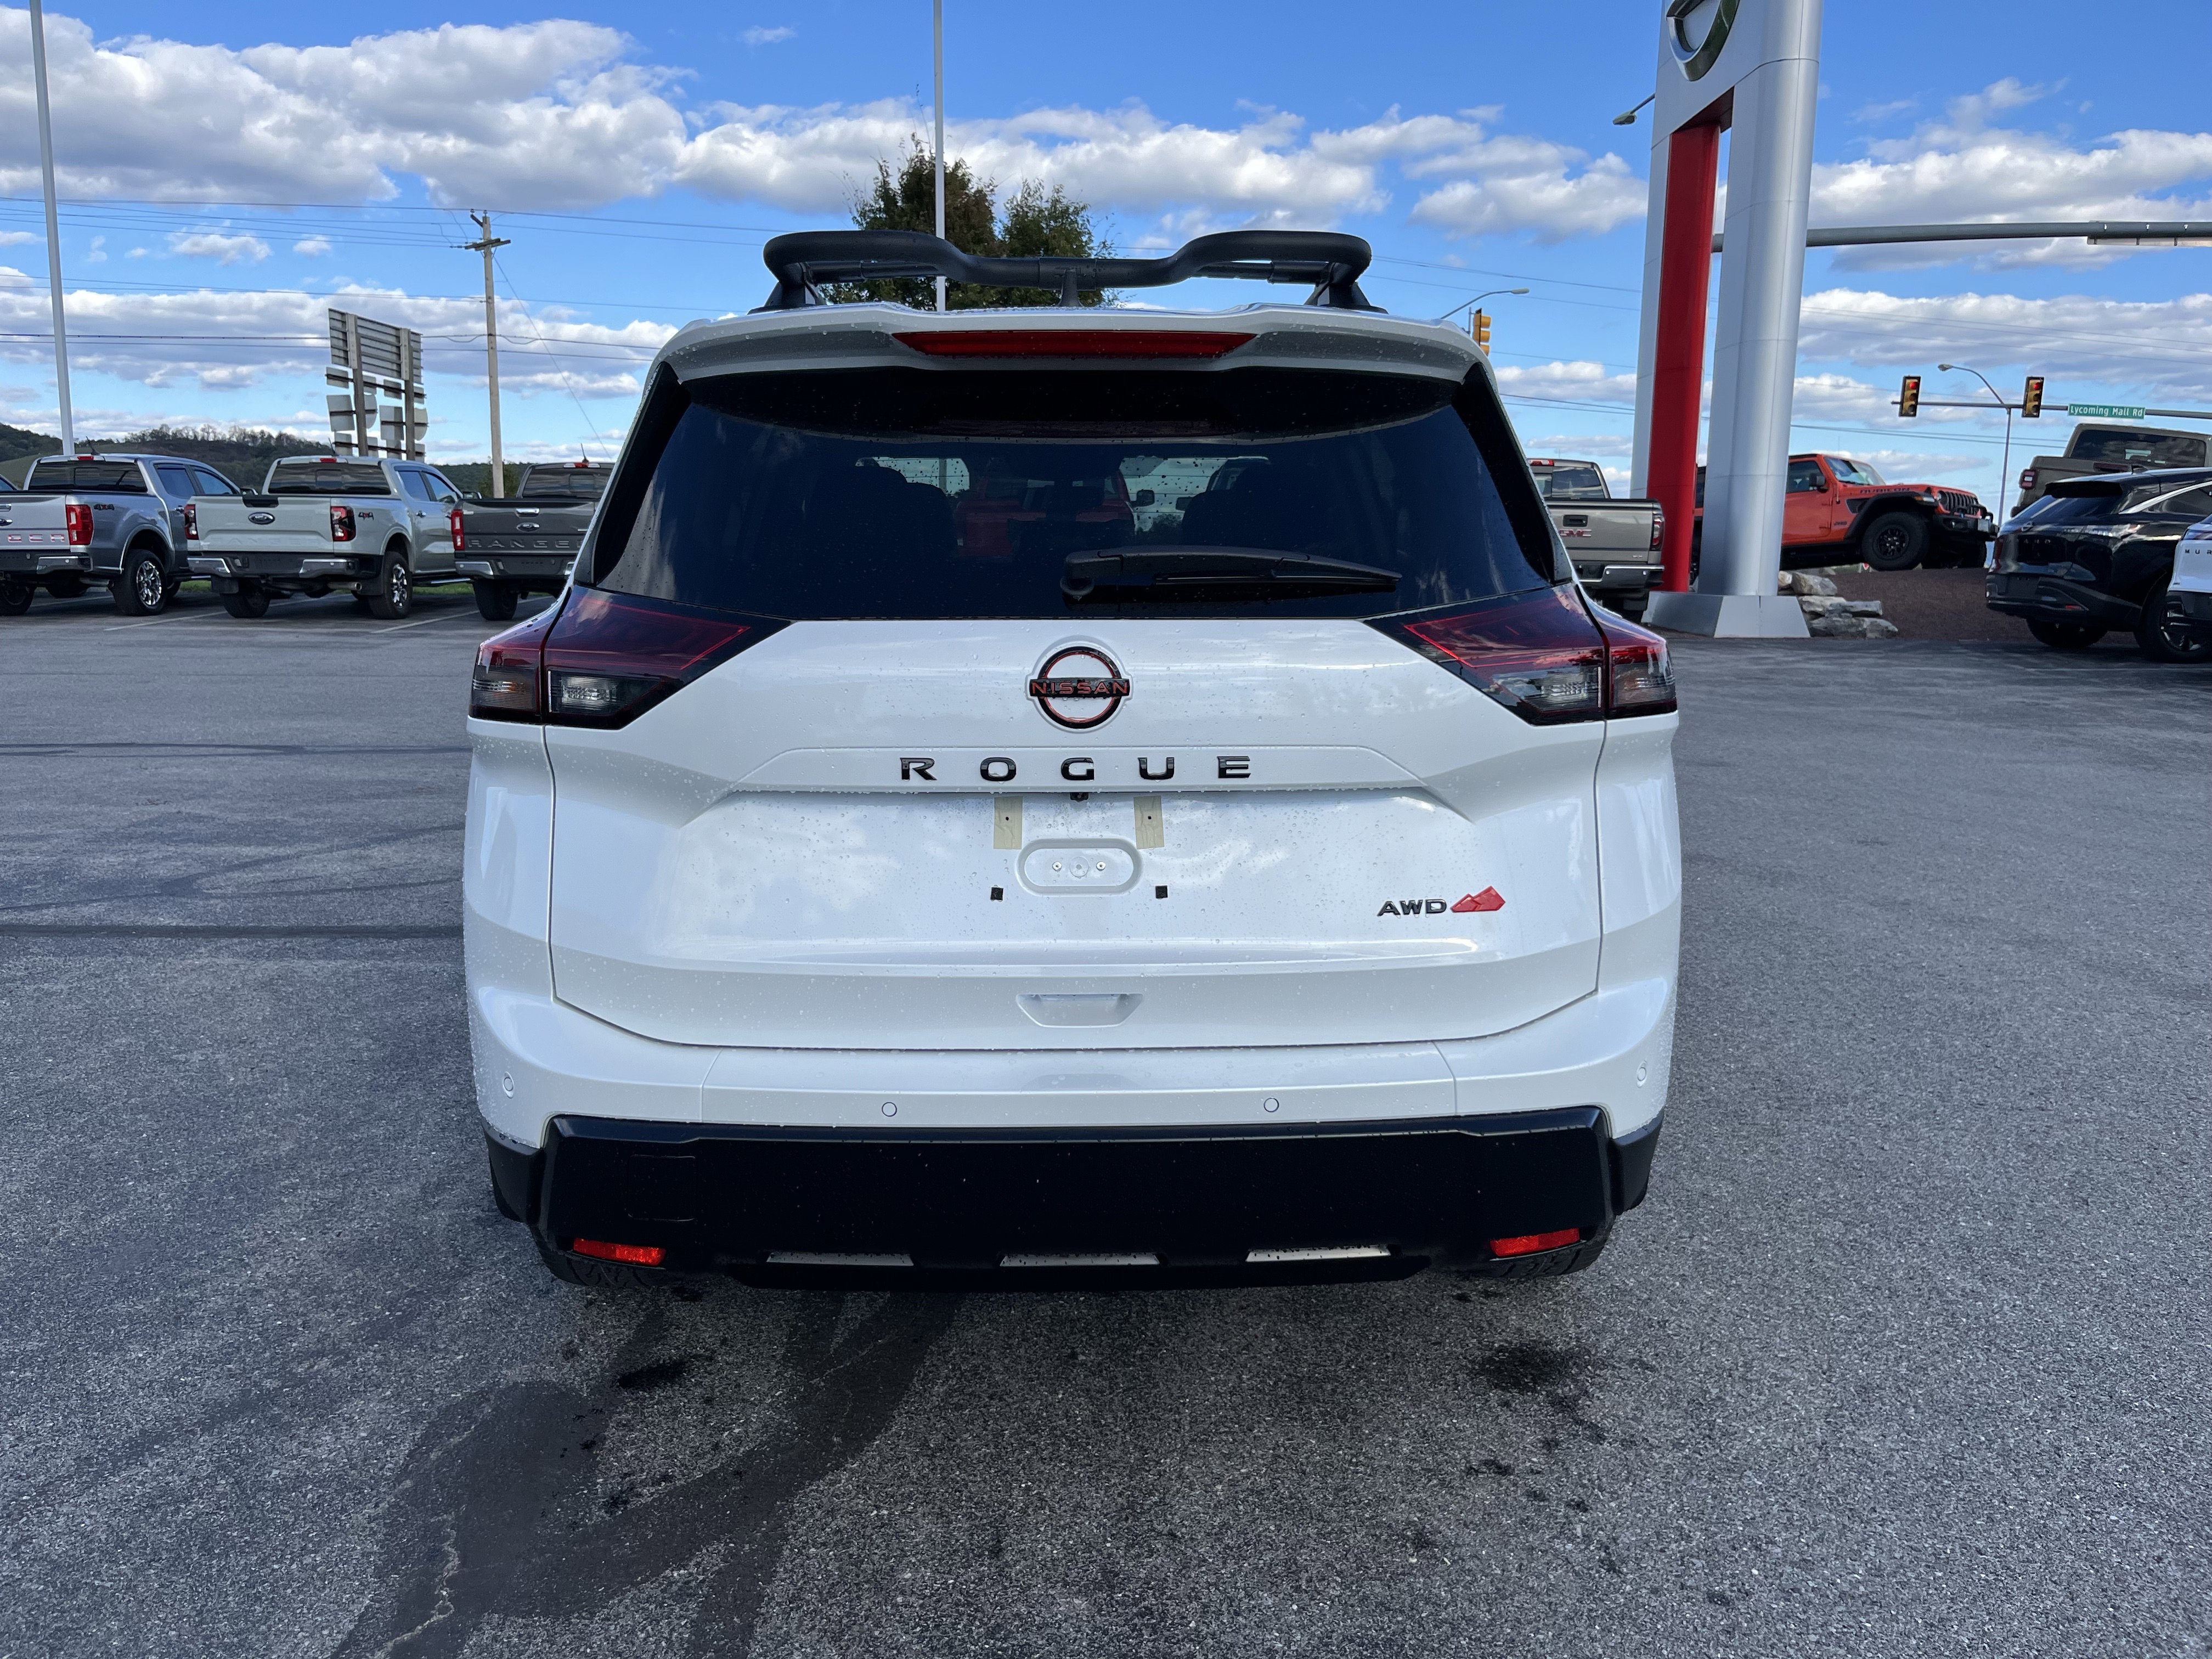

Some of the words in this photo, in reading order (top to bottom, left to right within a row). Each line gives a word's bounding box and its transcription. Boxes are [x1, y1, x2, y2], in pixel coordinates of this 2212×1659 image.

[2070, 405, 2109, 416] Lycoming
[2112, 408, 2129, 416] Mall
[2132, 408, 2143, 416] Rd
[1559, 529, 1592, 537] GMC
[1031, 681, 1128, 694] NISSAN
[899, 755, 1251, 782] ROGUE
[1377, 899, 1447, 917] AWD
